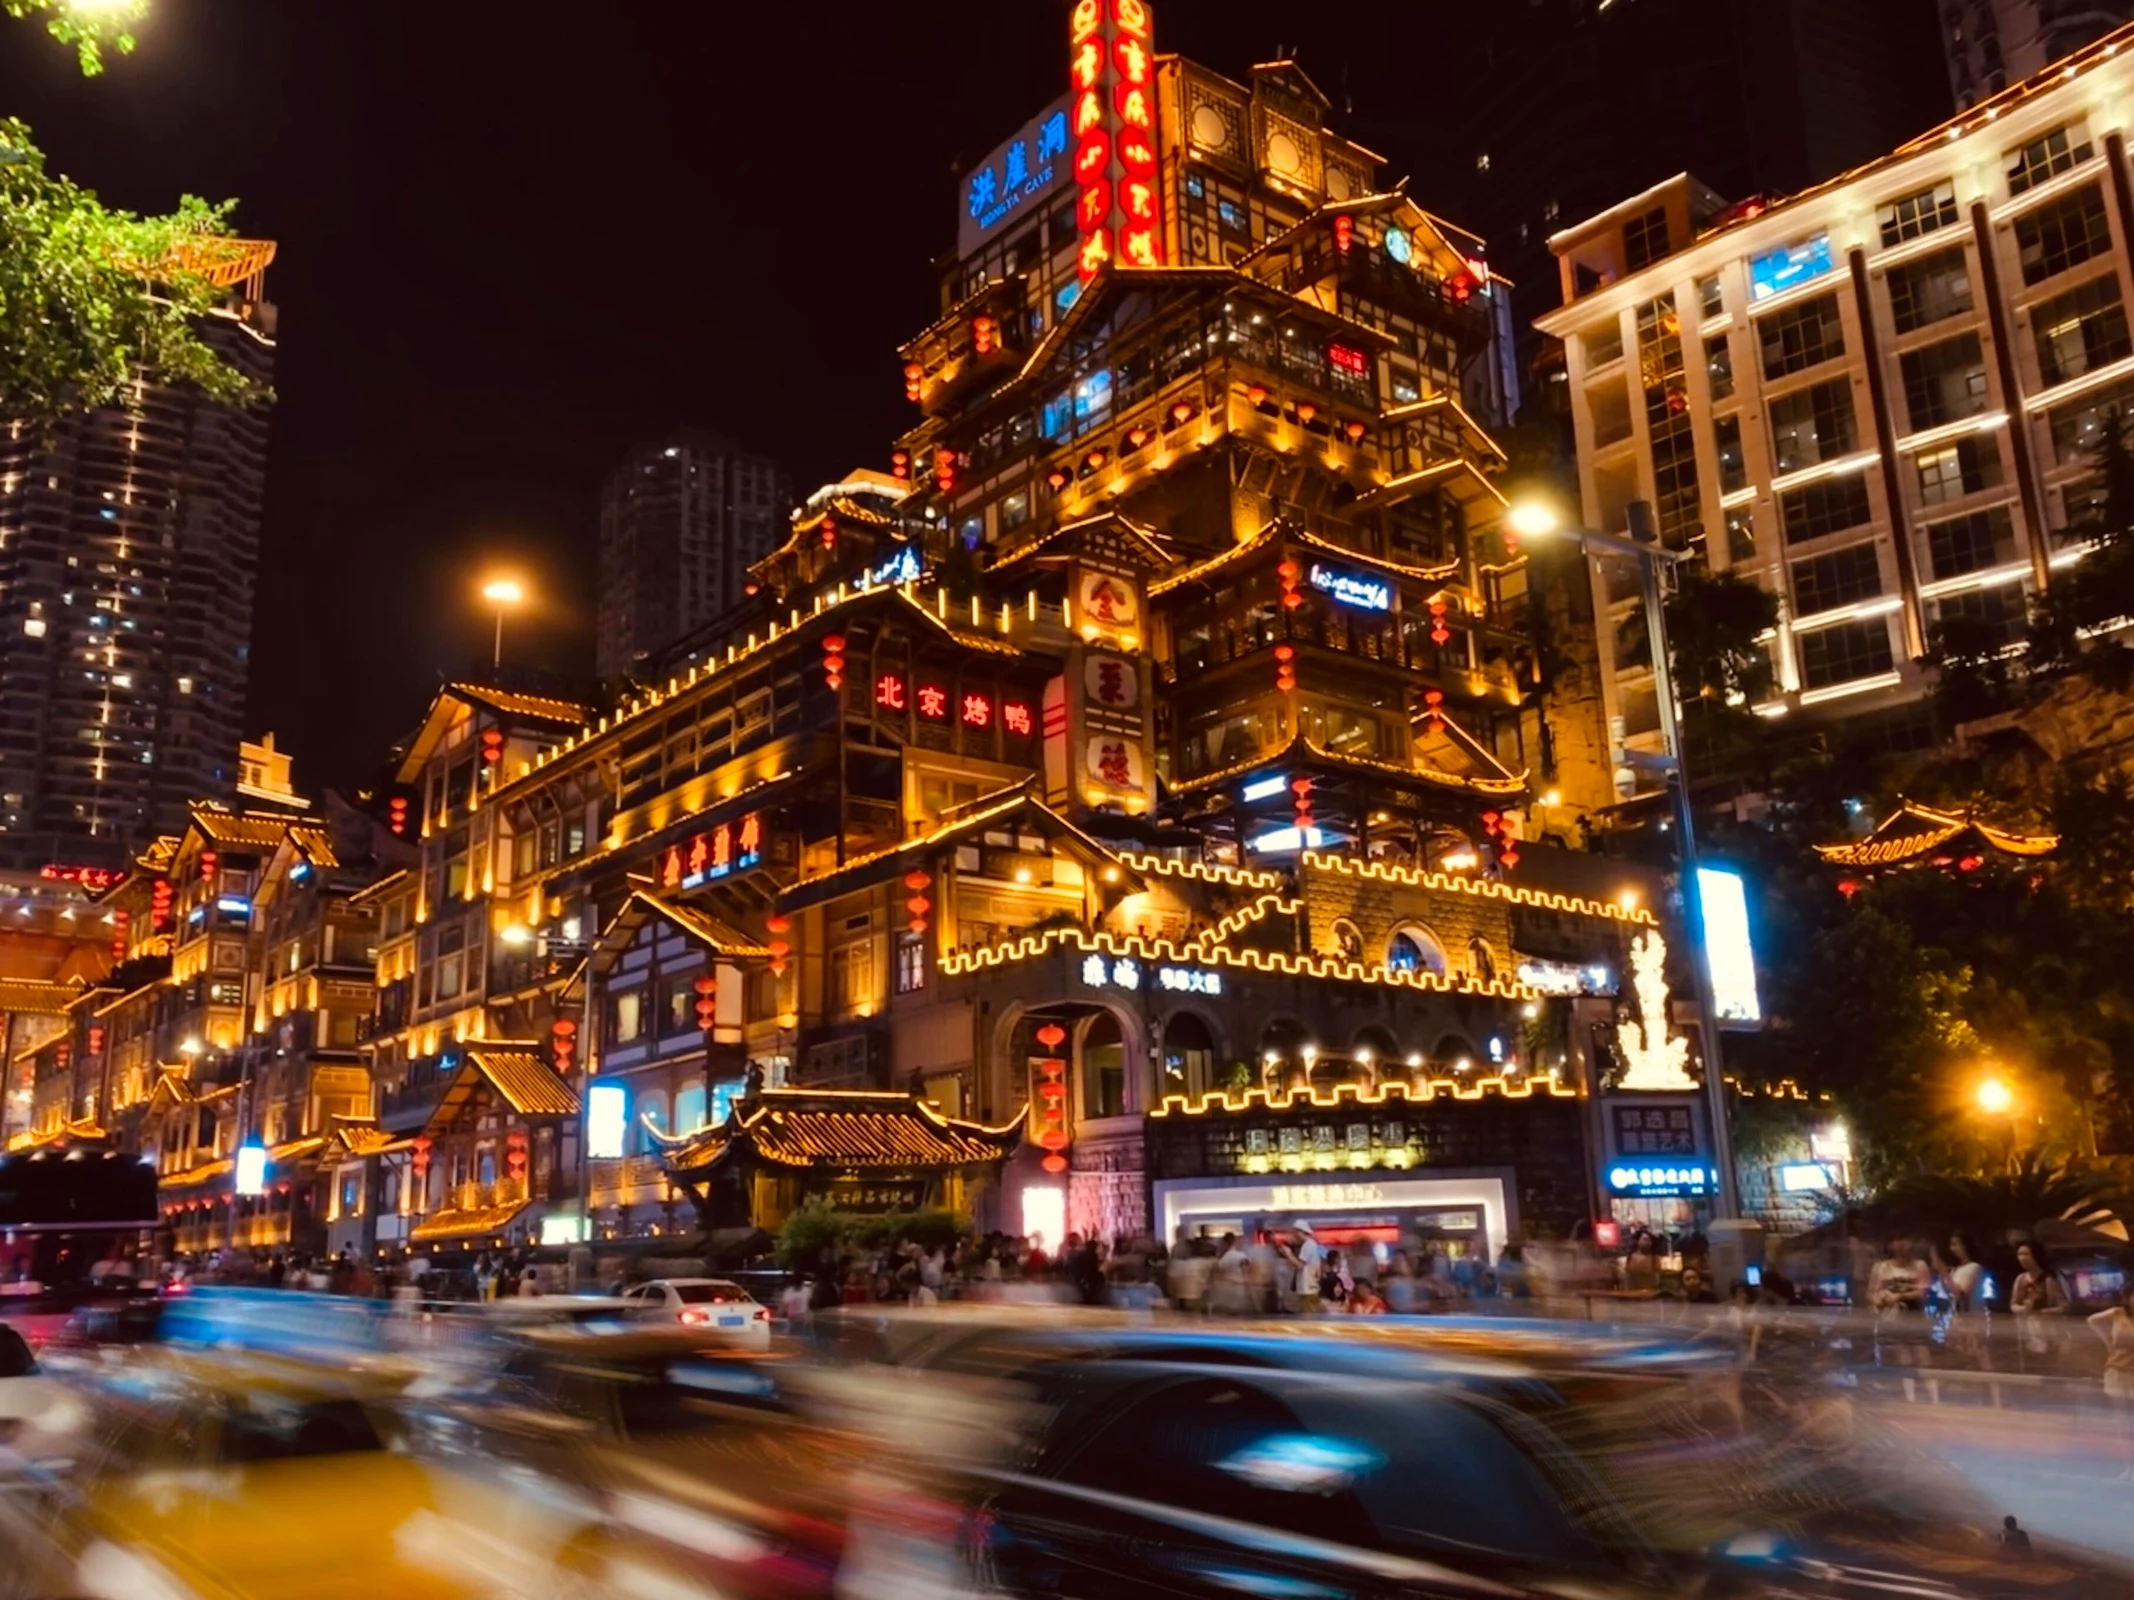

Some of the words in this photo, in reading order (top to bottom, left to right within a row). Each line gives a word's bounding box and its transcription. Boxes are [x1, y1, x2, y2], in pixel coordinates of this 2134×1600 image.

[968, 111, 1066, 217] 洪崖洞
[876, 676, 1031, 735] 北京烤鸭
